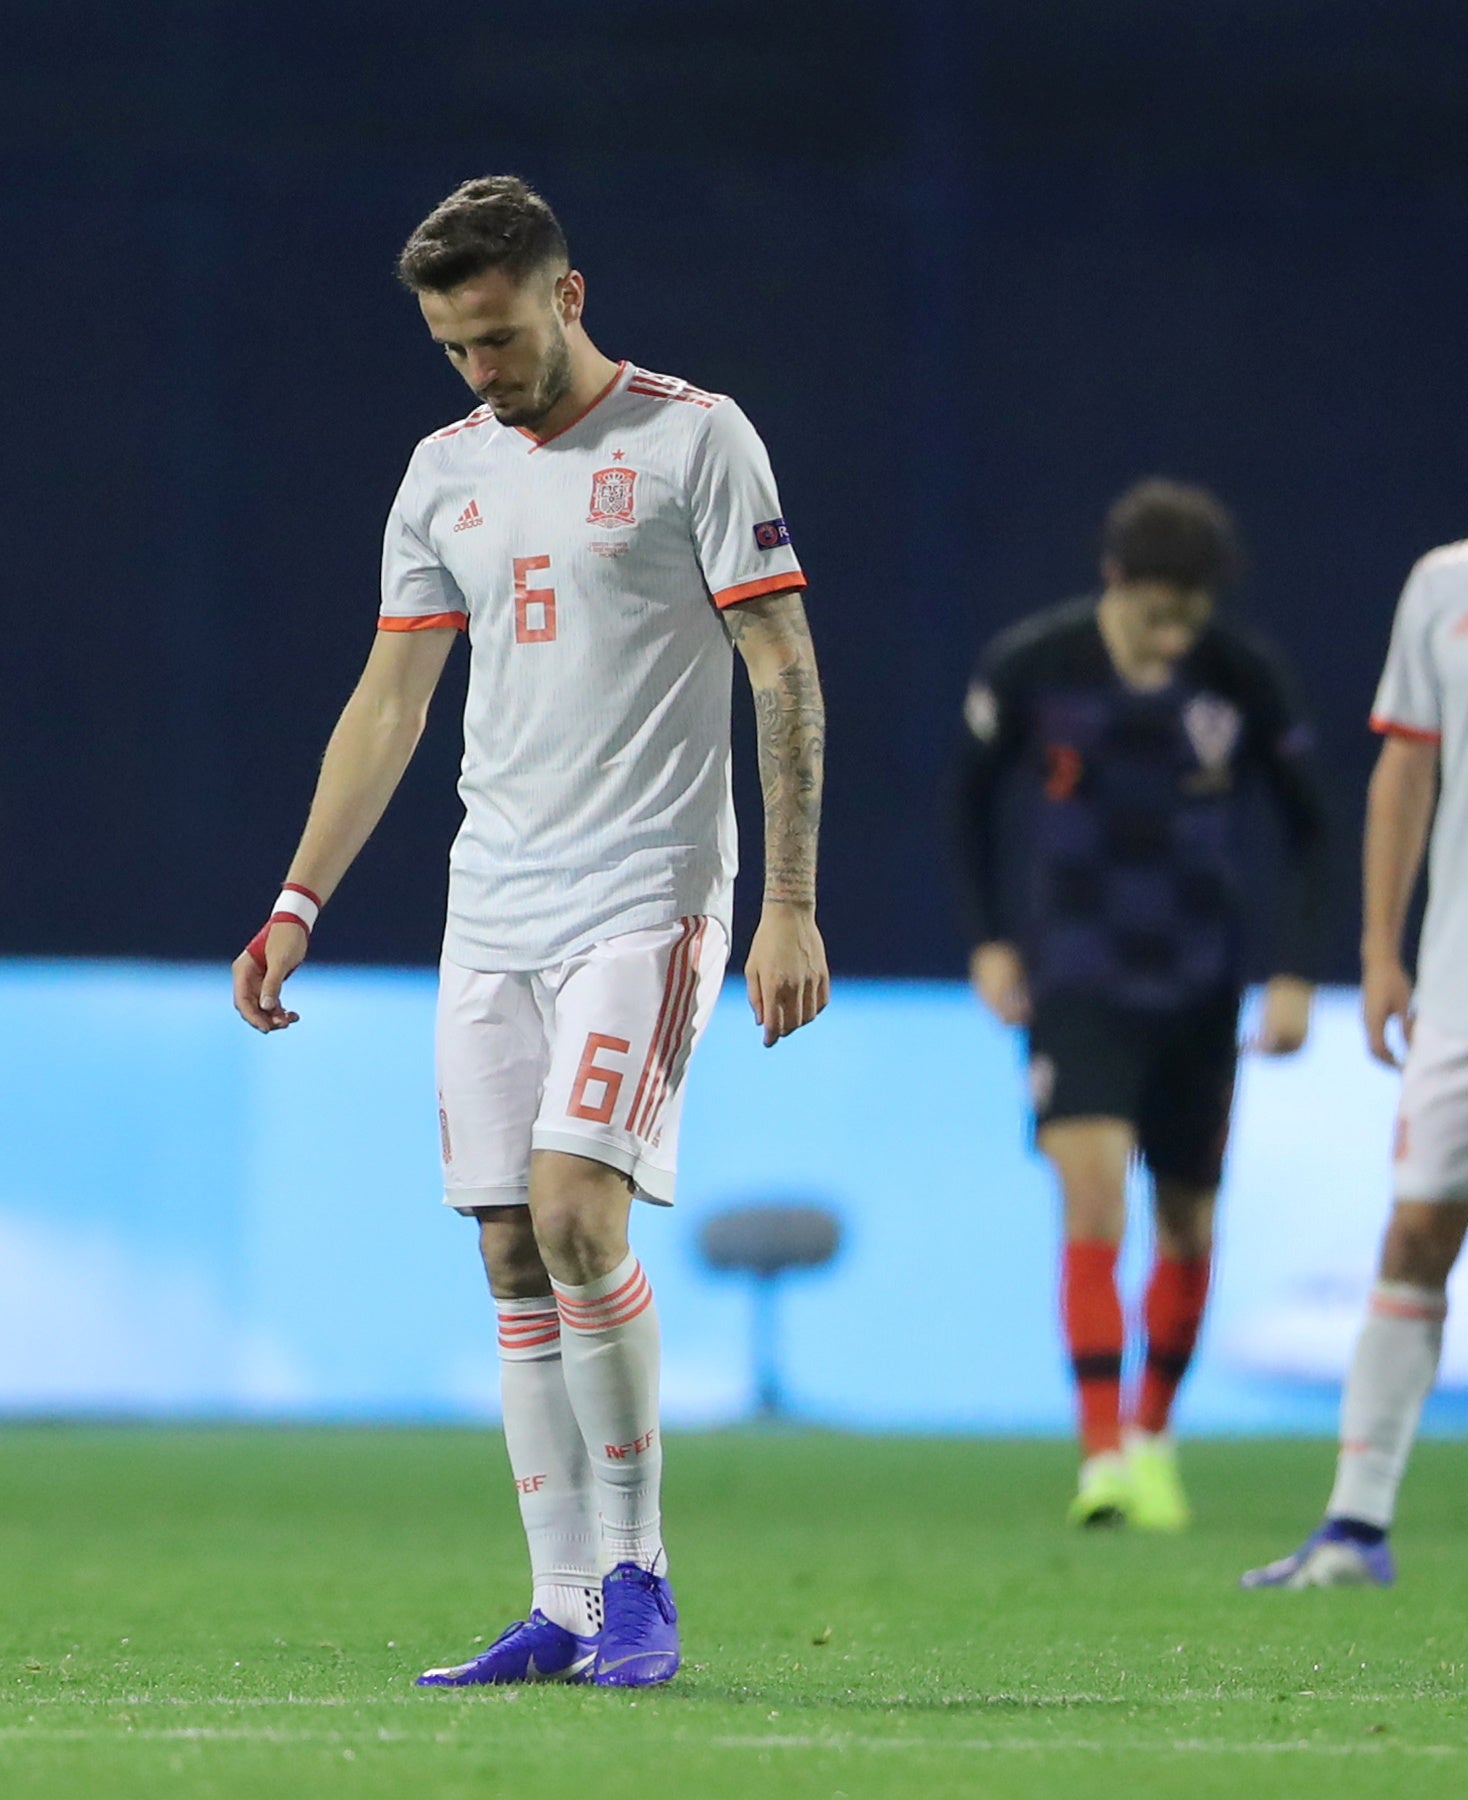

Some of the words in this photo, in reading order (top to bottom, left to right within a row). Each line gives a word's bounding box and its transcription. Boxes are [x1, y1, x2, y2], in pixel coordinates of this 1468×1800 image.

[512, 554, 557, 644] 6
[566, 1031, 631, 1125] 6
[604, 1428, 655, 1460] RFEF
